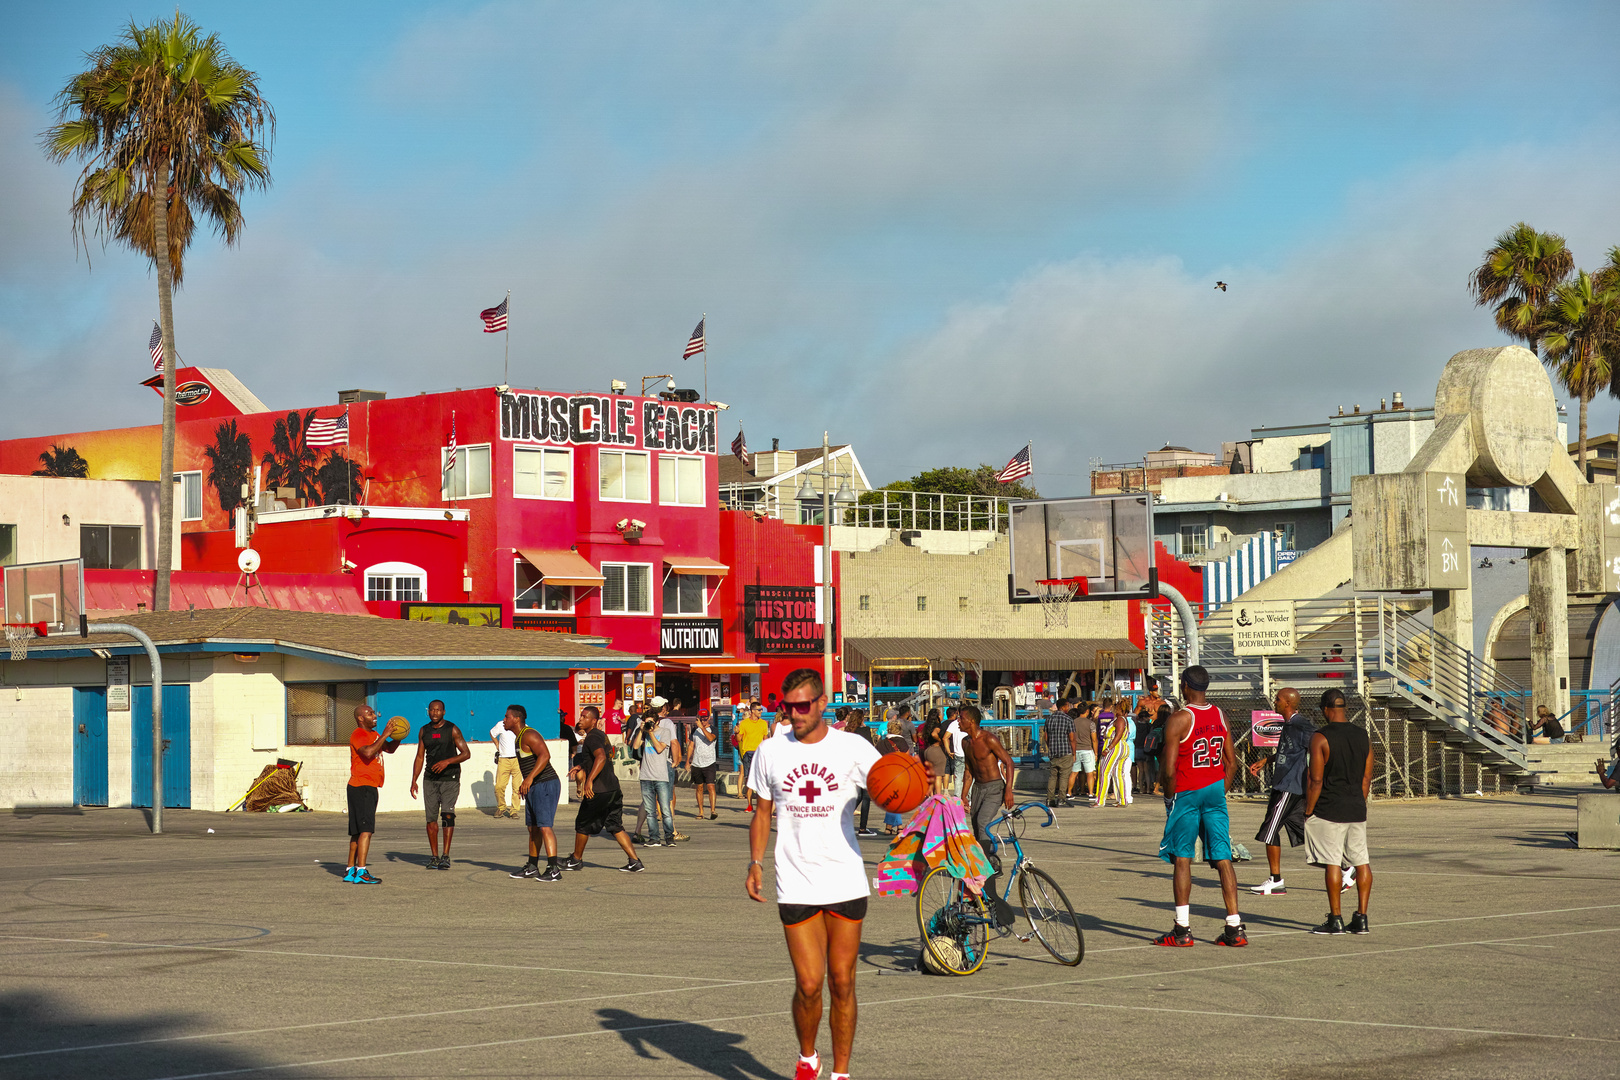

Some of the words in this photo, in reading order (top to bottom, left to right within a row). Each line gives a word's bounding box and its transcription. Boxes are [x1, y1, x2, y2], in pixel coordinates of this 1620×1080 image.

[500, 394, 636, 444] MUSCLE
[643, 401, 717, 454] BEACH
[1437, 488, 1458, 506] TN
[1442, 553, 1459, 572] BN
[755, 600, 816, 619] HISTOR
[1254, 615, 1265, 624] Joe
[661, 628, 719, 649] NUTRITION
[754, 621, 825, 640] MUSEUM
[1238, 639, 1290, 648] BODYBUILDING
[1194, 724, 1224, 736] GRIFFIN
[1192, 736, 1225, 768] 23
[782, 763, 839, 793] LIFEGUARD
